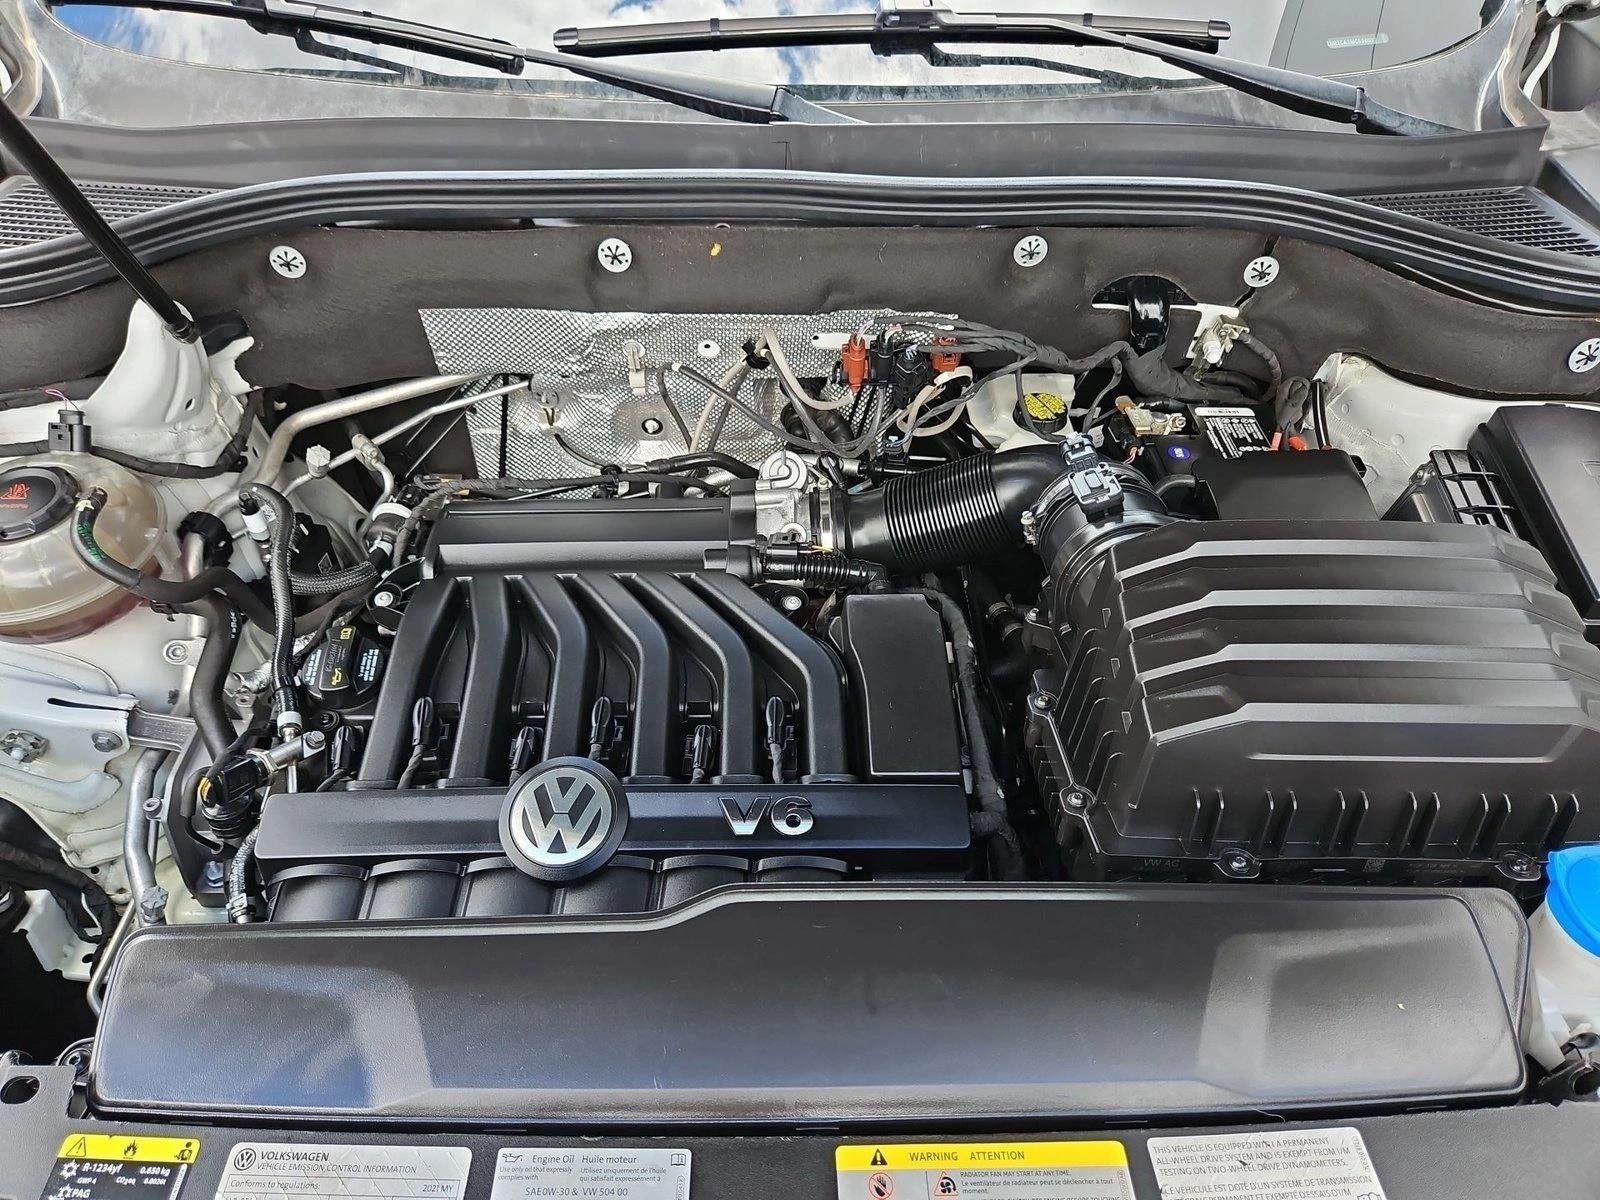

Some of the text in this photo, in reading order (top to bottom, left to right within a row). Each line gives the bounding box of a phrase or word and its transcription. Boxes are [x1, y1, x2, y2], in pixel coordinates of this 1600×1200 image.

[718, 795, 815, 837] V6
[1154, 1146, 1171, 1154] THIS
[1172, 1144, 1204, 1153] VEHICLE
[1205, 1144, 1212, 1152] IS
[1214, 1142, 1252, 1152] EQUIPPED
[1282, 1137, 1330, 1147] PERMANENT
[261, 1151, 330, 1162] VOLKSWAGEN
[532, 1154, 636, 1165] Engine Oil Huile moteur
[910, 1150, 1024, 1161] WARNING ATTENTION
[1157, 1156, 1200, 1165] ALL-WHEEL
[1200, 1154, 1224, 1162] DRIVE
[1225, 1152, 1254, 1162] SYSTEM
[1256, 1152, 1272, 1160] AND
[1282, 1149, 1312, 1158] EXEMPT
[1314, 1148, 1334, 1156] FROM
[82, 1162, 123, 1174] R-1234yf
[160, 1166, 171, 1176] kg
[258, 1162, 418, 1174] VEHICLE EMISSION CONTROL INFORMATION
[1160, 1168, 1192, 1176] TESTING
[1193, 1166, 1206, 1174] ON
[1258, 1162, 1281, 1172] DRIVE
[230, 1180, 266, 1188] Conforms
[422, 1184, 438, 1192] 2021
[440, 1184, 454, 1193] MY
[572, 1186, 578, 1196] &
[582, 1187, 598, 1196] VW
[600, 1187, 615, 1196] 504
[617, 1188, 628, 1196] 00
[1176, 1184, 1213, 1194] VEHICULE
[1214, 1184, 1226, 1192] EST
[1305, 1178, 1316, 1186] DE
[1317, 1175, 1372, 1186] TRANSMISSION
[72, 1188, 90, 1198] PAG
